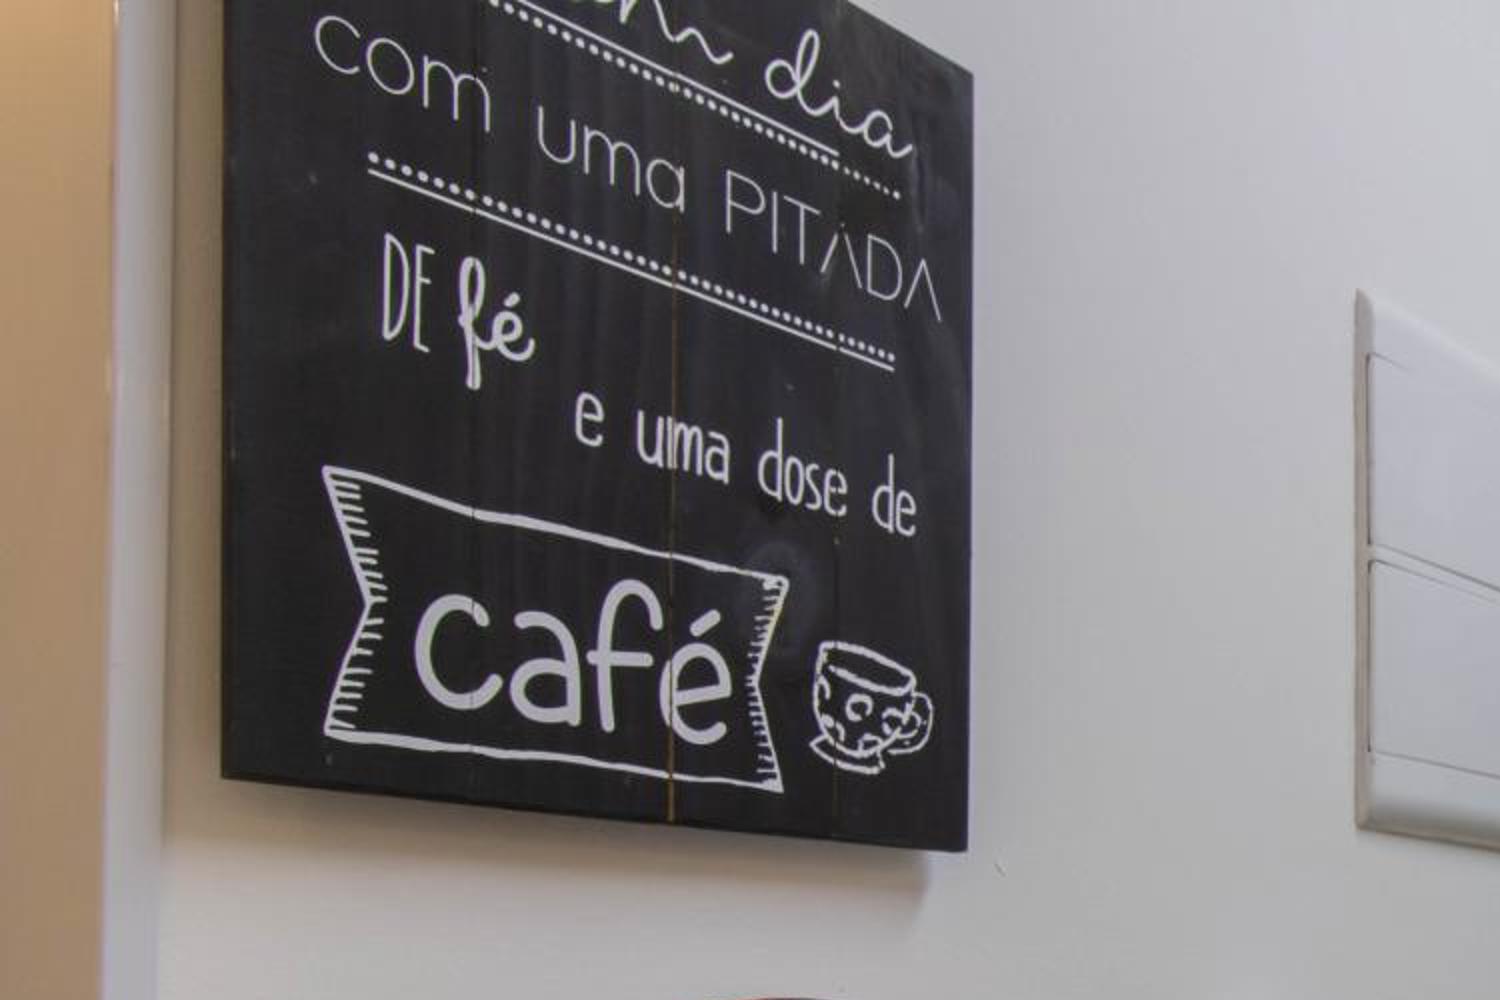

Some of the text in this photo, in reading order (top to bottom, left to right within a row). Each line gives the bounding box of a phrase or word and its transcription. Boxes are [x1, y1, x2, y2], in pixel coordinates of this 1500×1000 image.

[314, 15, 491, 133] com
[537, 104, 686, 213] uma
[725, 168, 943, 323] PITADA
[764, 28, 914, 159] dia
[380, 232, 536, 391] DE fé
[574, 391, 917, 537] e uma dose de
[413, 578, 734, 746] café
